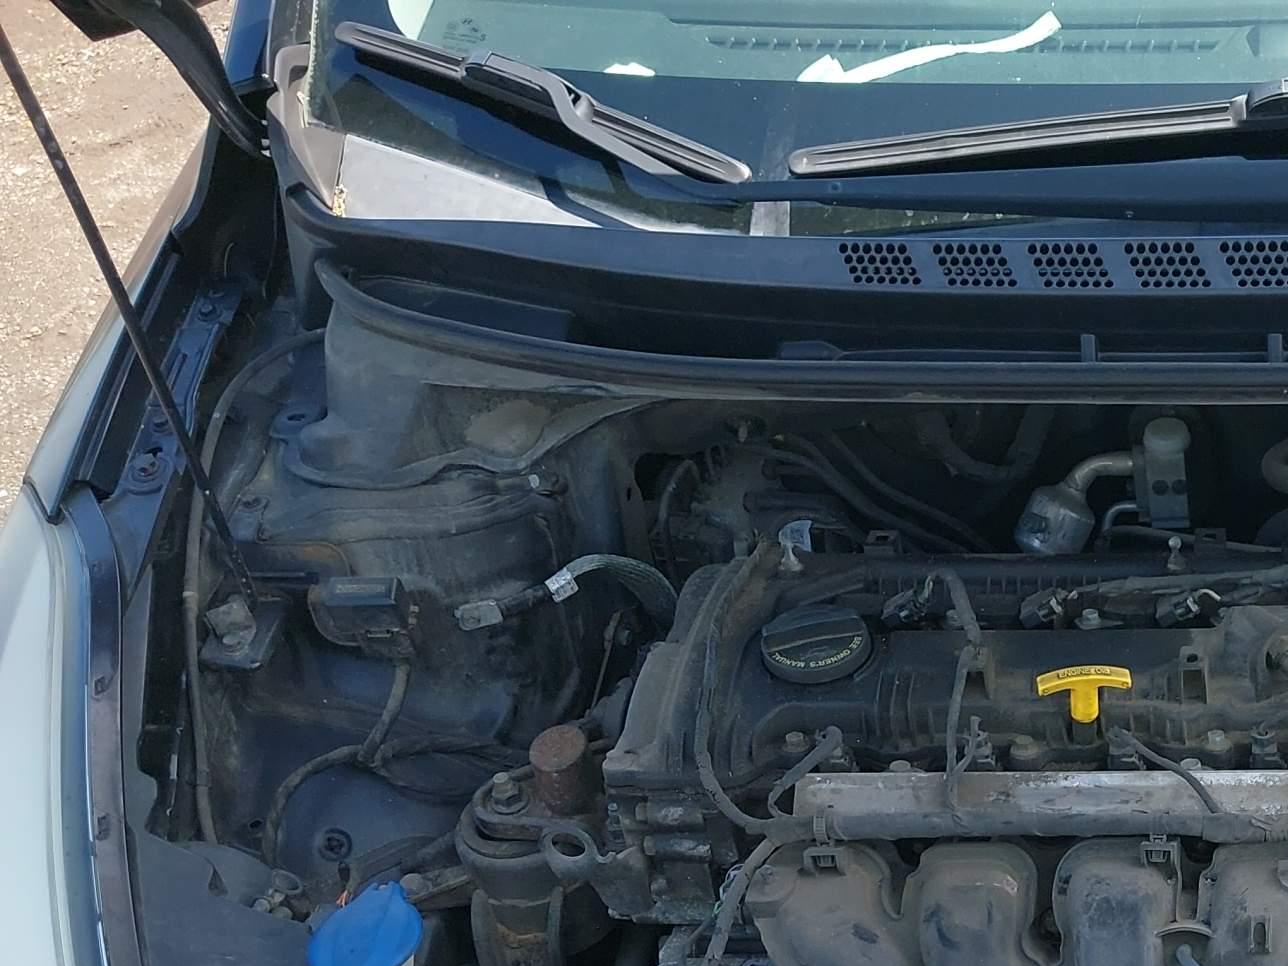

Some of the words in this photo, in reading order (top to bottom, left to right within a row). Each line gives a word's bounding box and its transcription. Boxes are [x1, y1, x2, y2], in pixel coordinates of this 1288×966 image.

[848, 636, 863, 650] SEE
[771, 652, 806, 668] MANUAL
[809, 649, 852, 668] OWNER'S
[1059, 668, 1090, 679] ENGINE
